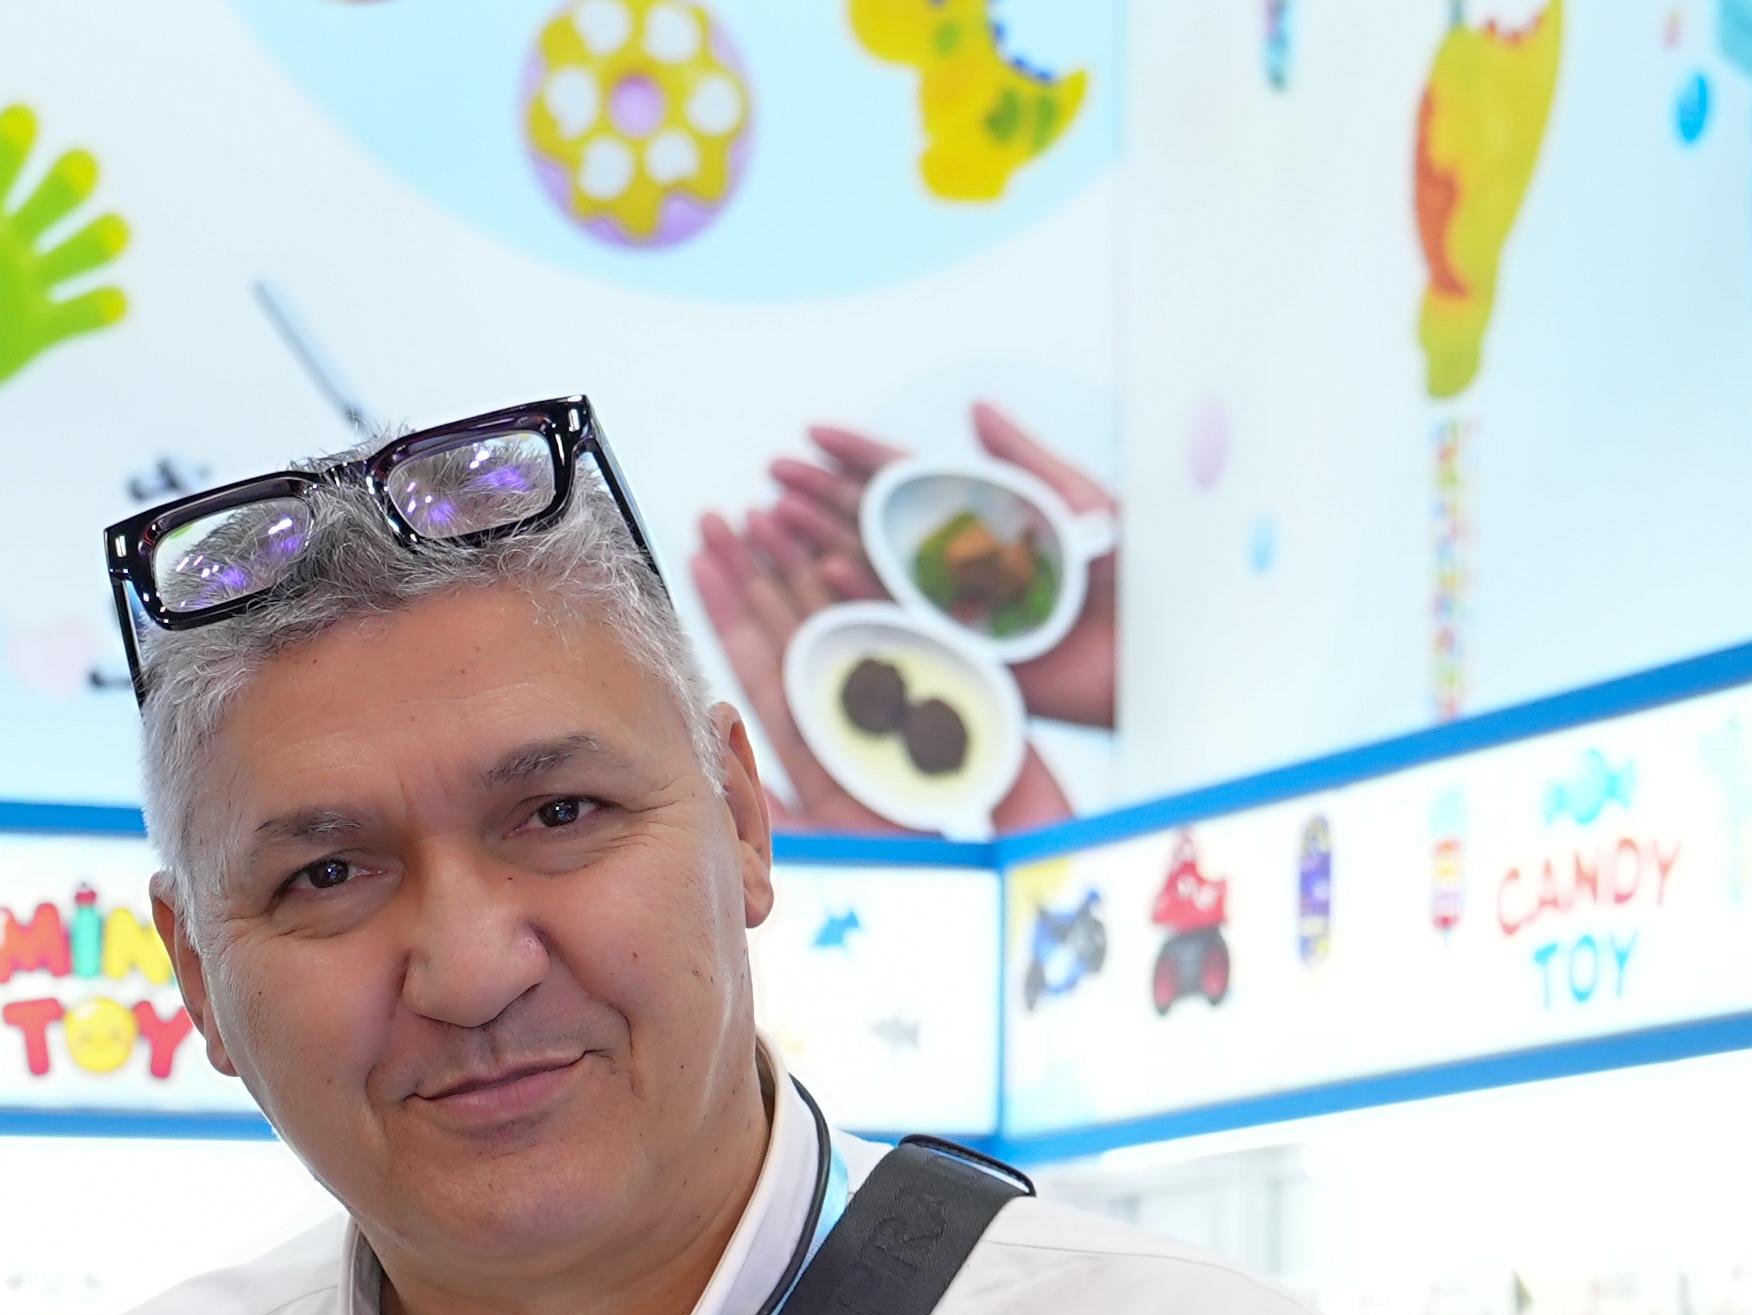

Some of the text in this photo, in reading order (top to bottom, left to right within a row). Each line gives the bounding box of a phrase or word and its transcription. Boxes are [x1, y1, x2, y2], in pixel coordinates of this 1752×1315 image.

[1497, 837, 1682, 936] CANDY
[1534, 932, 1638, 1010] TOY
[2, 994, 193, 1079] TOY
